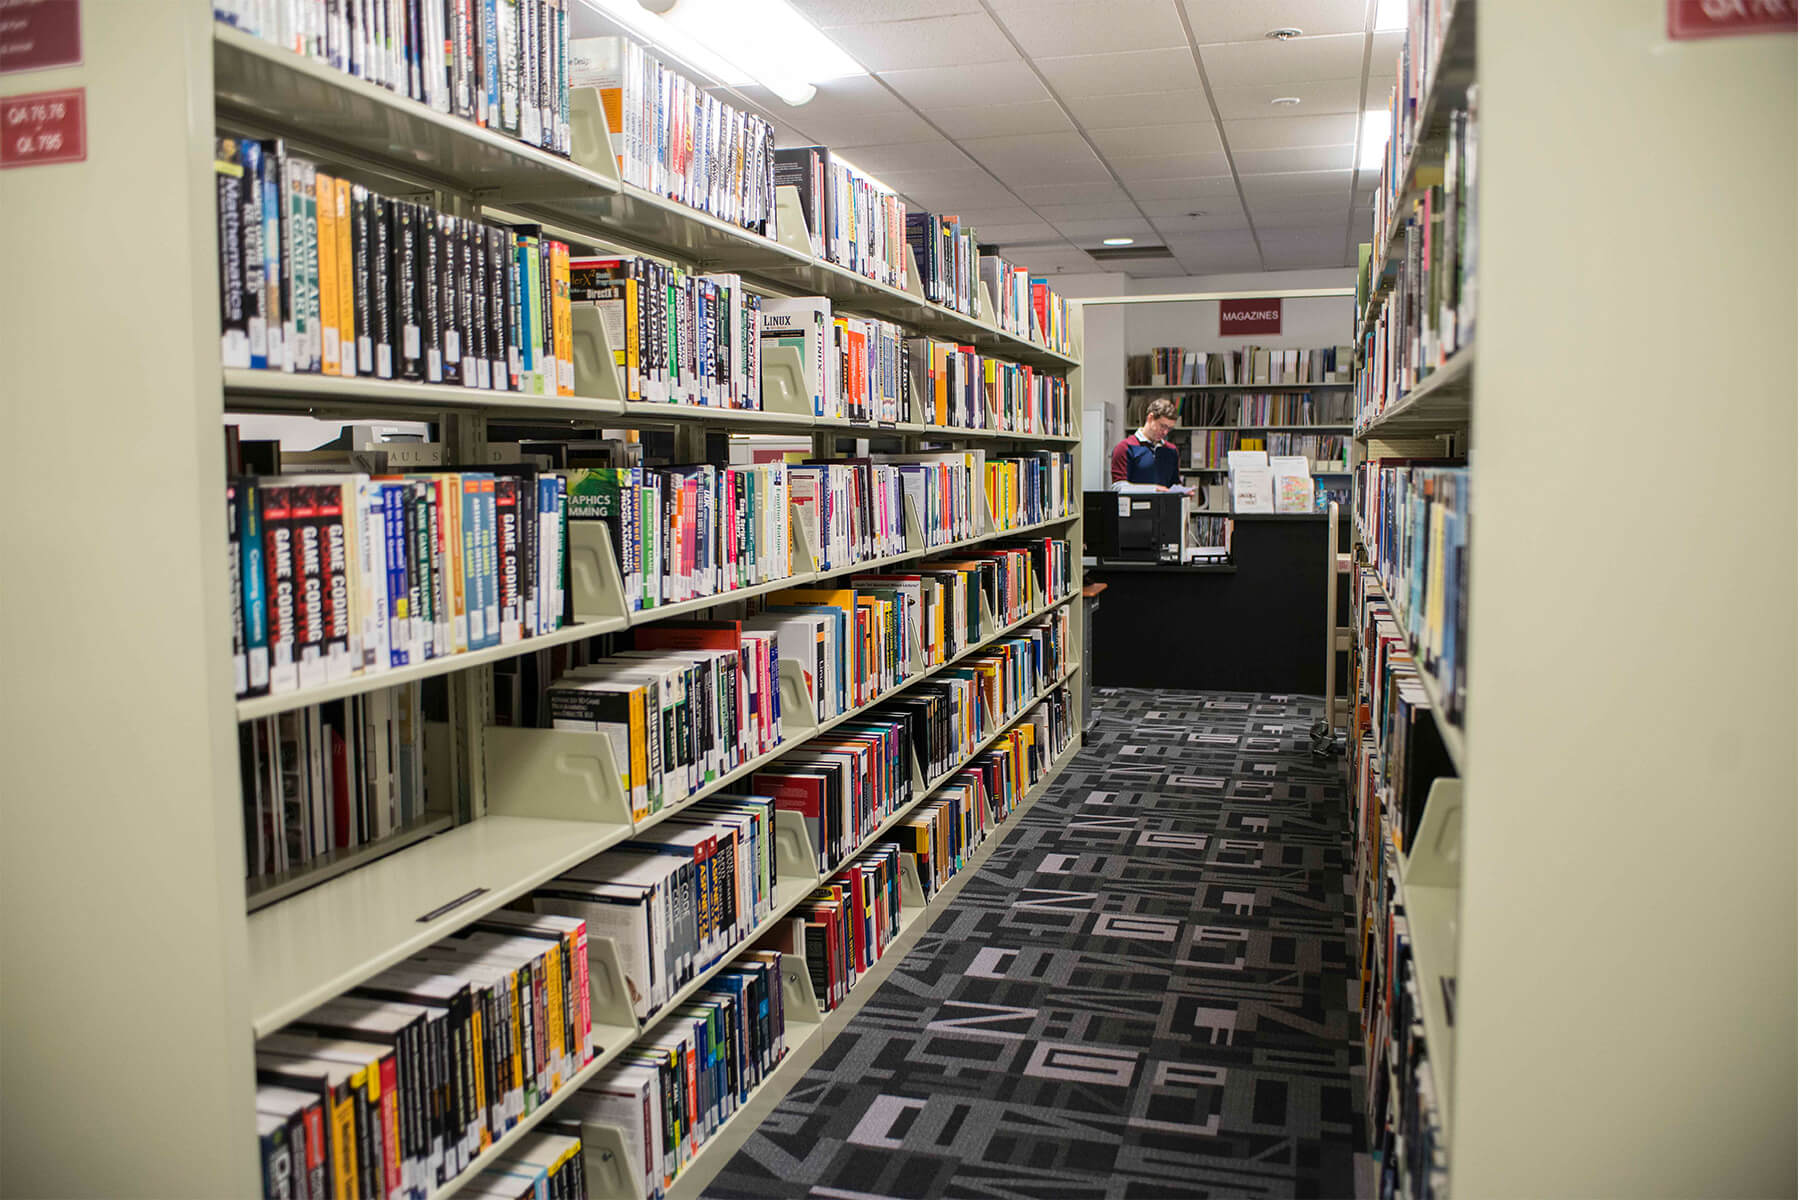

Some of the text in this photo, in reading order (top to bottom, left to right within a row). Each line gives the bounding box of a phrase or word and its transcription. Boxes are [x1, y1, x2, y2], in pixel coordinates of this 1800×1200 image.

[8, 103, 65, 124] QA 76.76
[17, 137, 34, 155] QL
[225, 178, 243, 320] Mathematics
[293, 213, 306, 320] GAME ART
[305, 217, 317, 278] GAME
[639, 285, 647, 349] SHADER
[764, 315, 791, 326] LINUX
[1223, 310, 1279, 321] MAGAZINES
[706, 318, 716, 376] DirectX
[419, 532, 428, 559] GAME
[473, 498, 482, 545] ARTIFICIAL
[488, 497, 497, 544] ARTIFICIAL
[275, 528, 292, 578] GAME
[467, 550, 475, 578] GAMES
[504, 514, 517, 606] GAME CODING
[303, 526, 323, 642] GAME CODING
[329, 524, 347, 637] GAME CODING
[680, 882, 690, 919] CODE
[700, 865, 708, 919] ASP.NET
